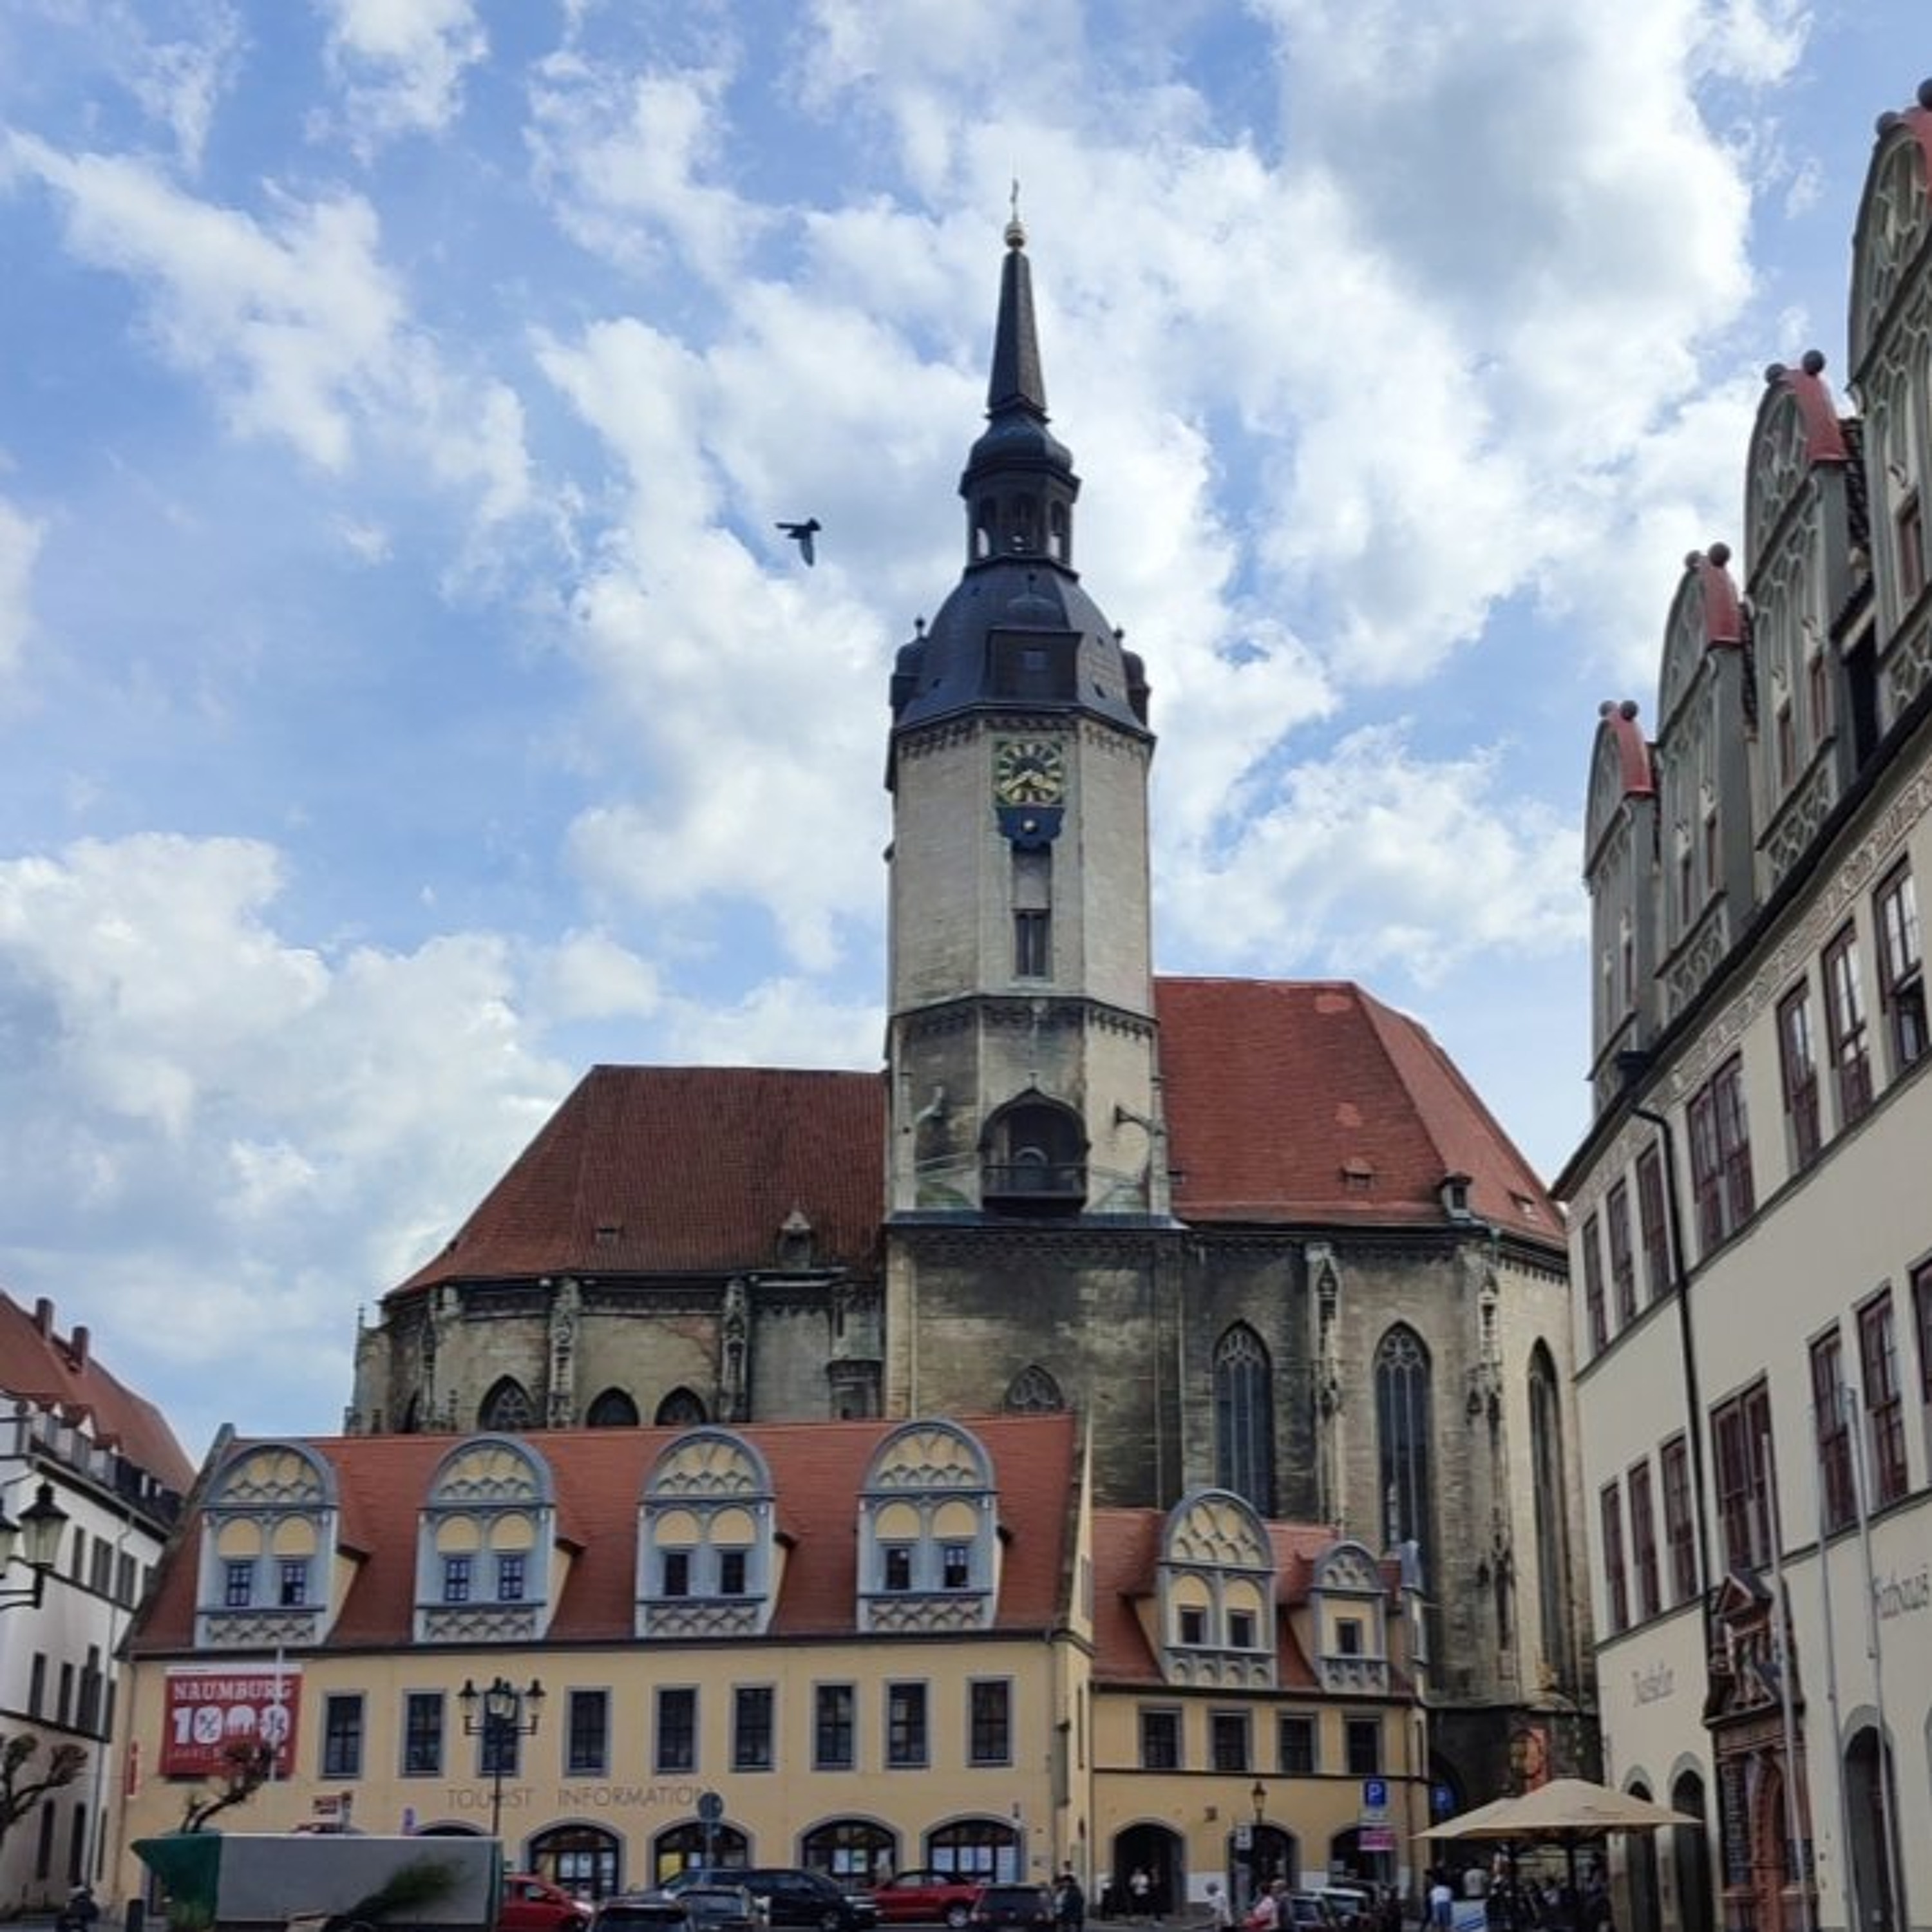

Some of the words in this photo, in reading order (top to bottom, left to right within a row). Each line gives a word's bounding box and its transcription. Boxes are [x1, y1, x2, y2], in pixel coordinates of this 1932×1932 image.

[173, 1680, 292, 1701] NAUMBURG
[172, 1704, 290, 1745] 1000
[1367, 1783, 1383, 1803] P
